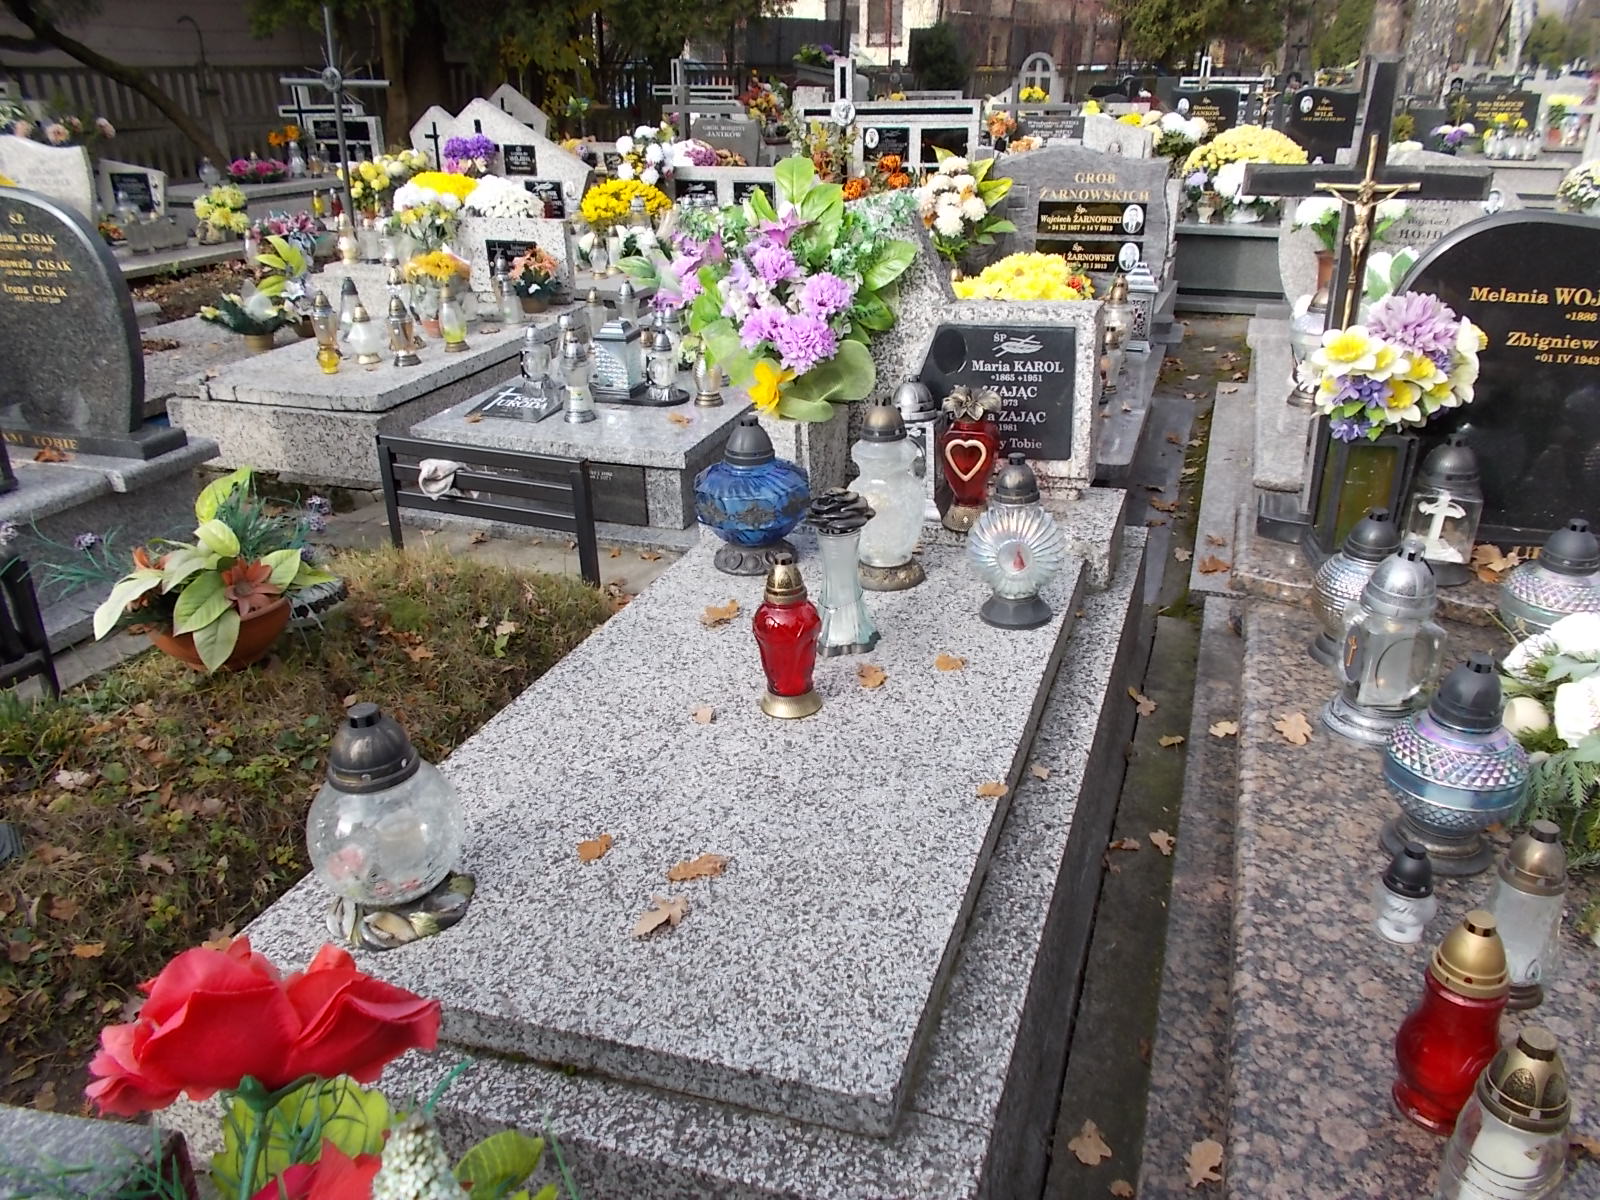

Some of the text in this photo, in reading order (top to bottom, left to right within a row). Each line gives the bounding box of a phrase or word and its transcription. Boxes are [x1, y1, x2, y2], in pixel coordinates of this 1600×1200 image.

[1040, 214, 1122, 224] Wojciech ŻARNOWSKI
[1066, 251, 1116, 262] ŻARNOWSKI
[1469, 287, 1549, 305] Melania
[1505, 332, 1599, 351] Zbigniew
[972, 360, 1065, 373] Maria KAROL
[999, 411, 1047, 425] ZAJĄC
[1010, 438, 1042, 449] Tobie
